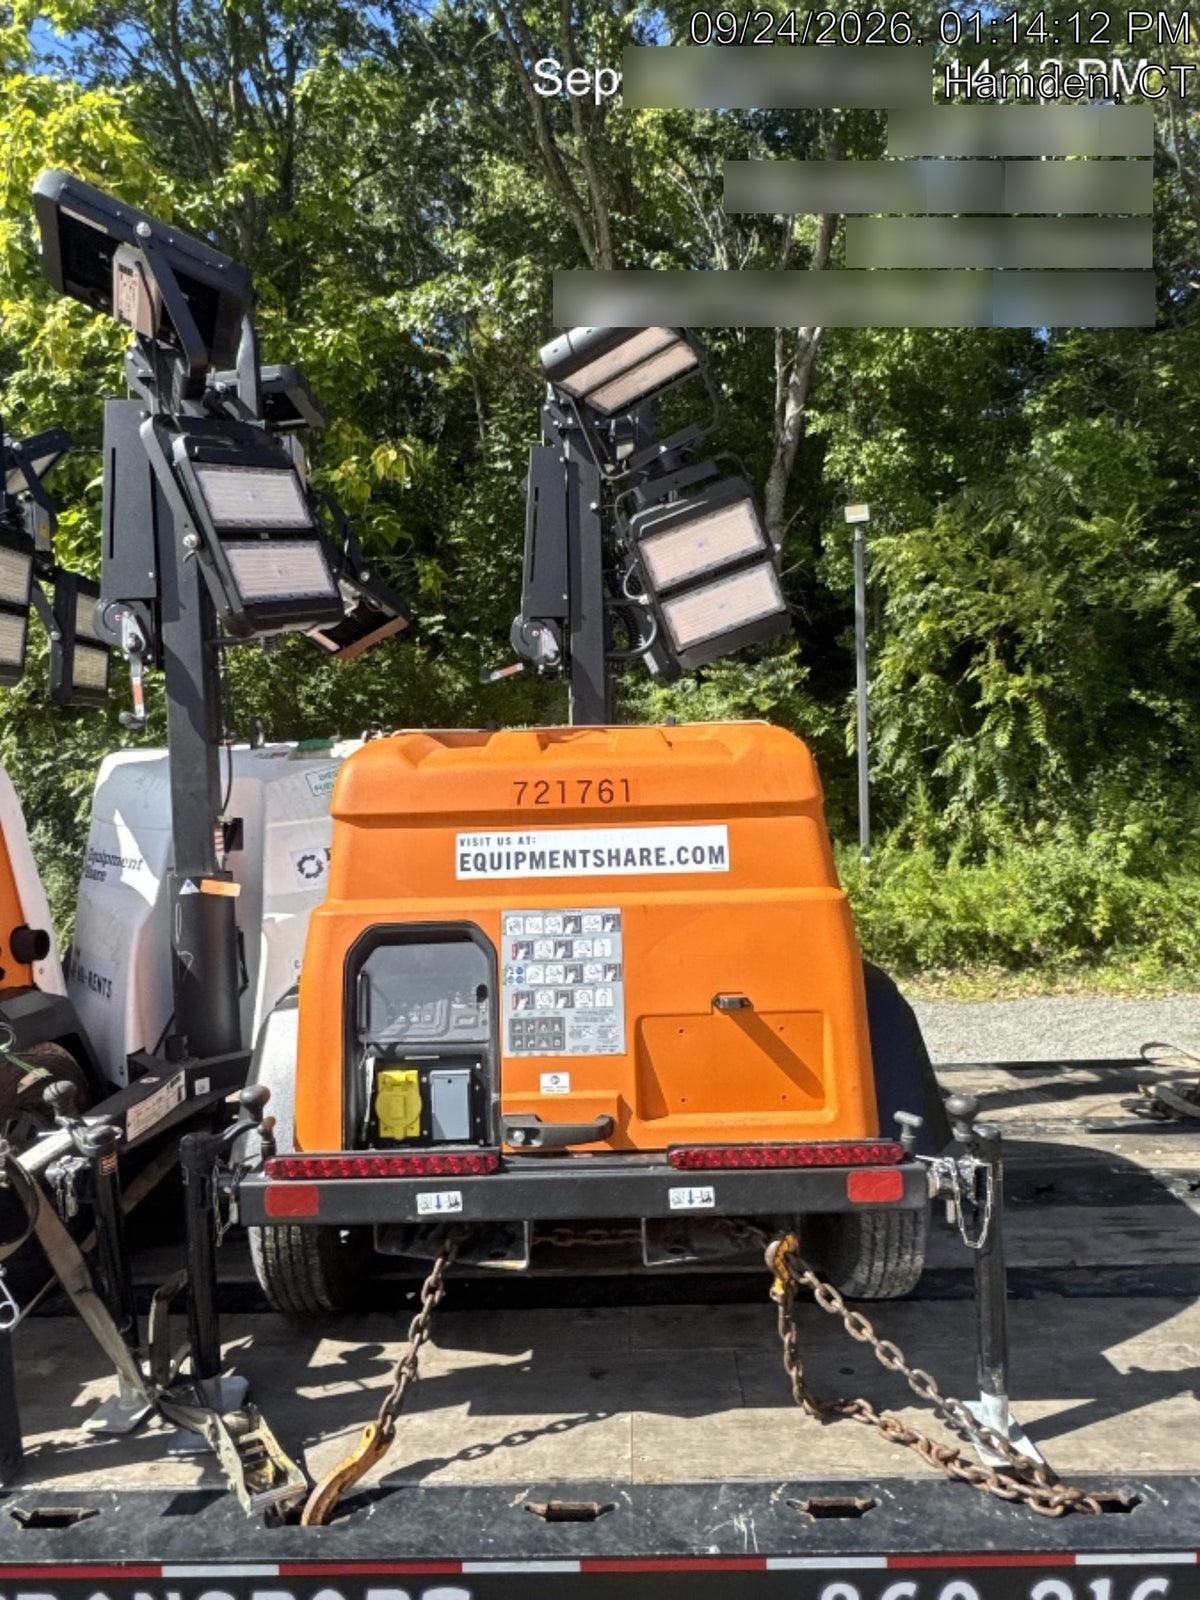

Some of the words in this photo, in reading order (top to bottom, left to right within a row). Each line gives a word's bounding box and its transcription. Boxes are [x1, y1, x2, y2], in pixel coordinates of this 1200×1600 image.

[513, 778, 632, 806] 721761
[459, 836, 491, 847] VISIT
[497, 835, 512, 846] US
[517, 835, 537, 846] AT:
[459, 845, 726, 873] EQUIPMENTSHARE.COM
